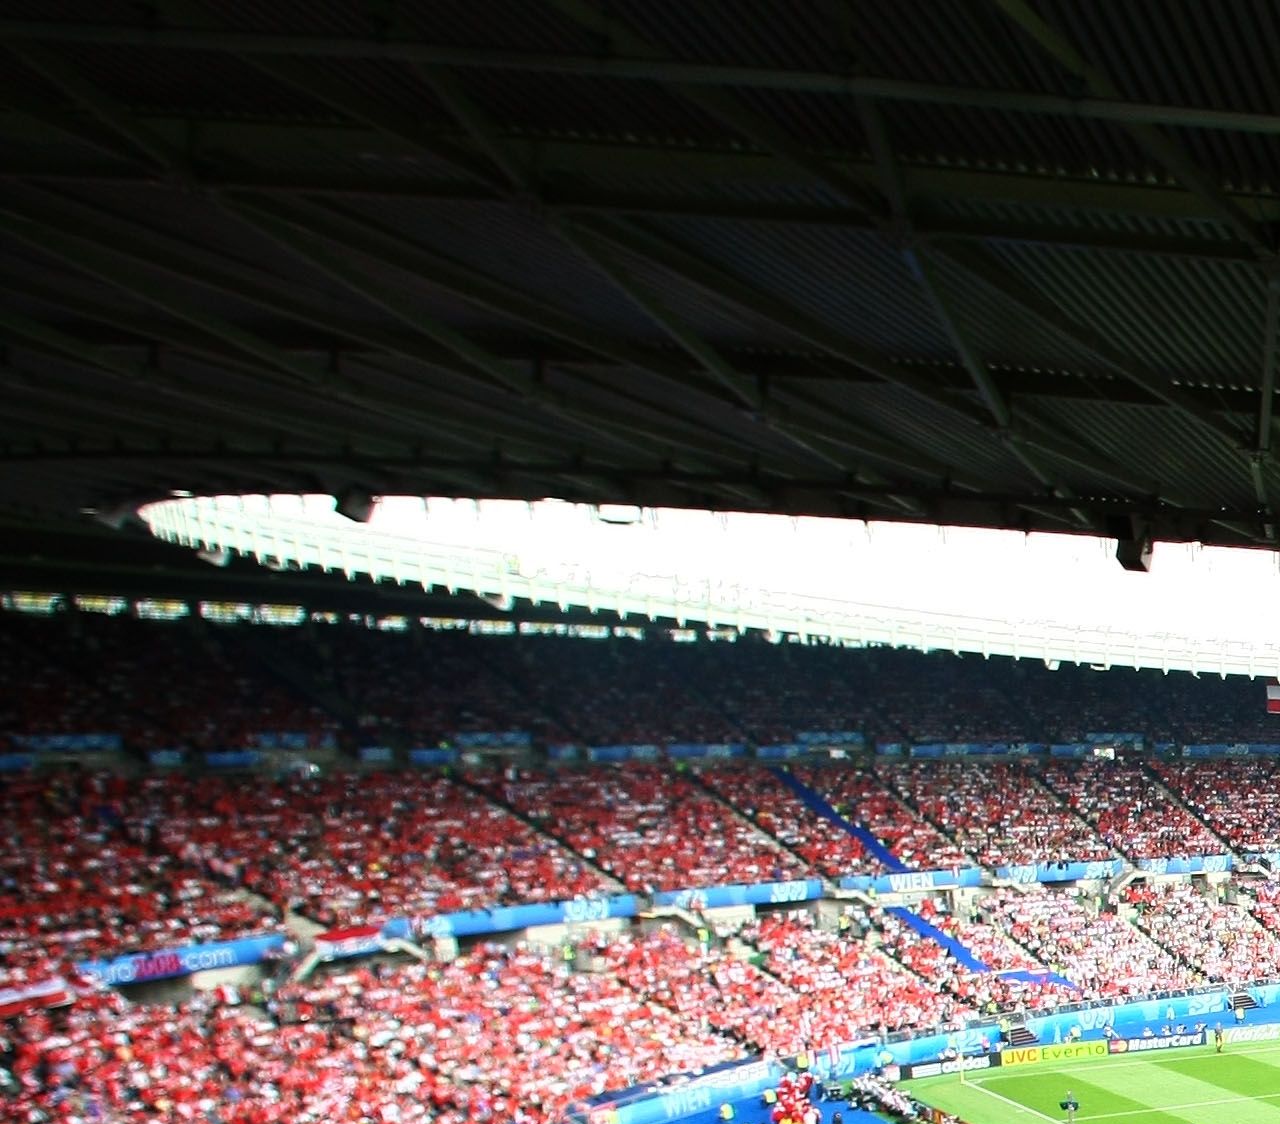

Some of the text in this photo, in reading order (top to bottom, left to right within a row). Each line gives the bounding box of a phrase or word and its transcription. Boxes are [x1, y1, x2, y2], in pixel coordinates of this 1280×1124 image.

[890, 872, 934, 892] WIEN
[1128, 1033, 1201, 1051] MasterCard
[1005, 1044, 1105, 1064] JVC Everio
[664, 1088, 711, 1118] WIEN
